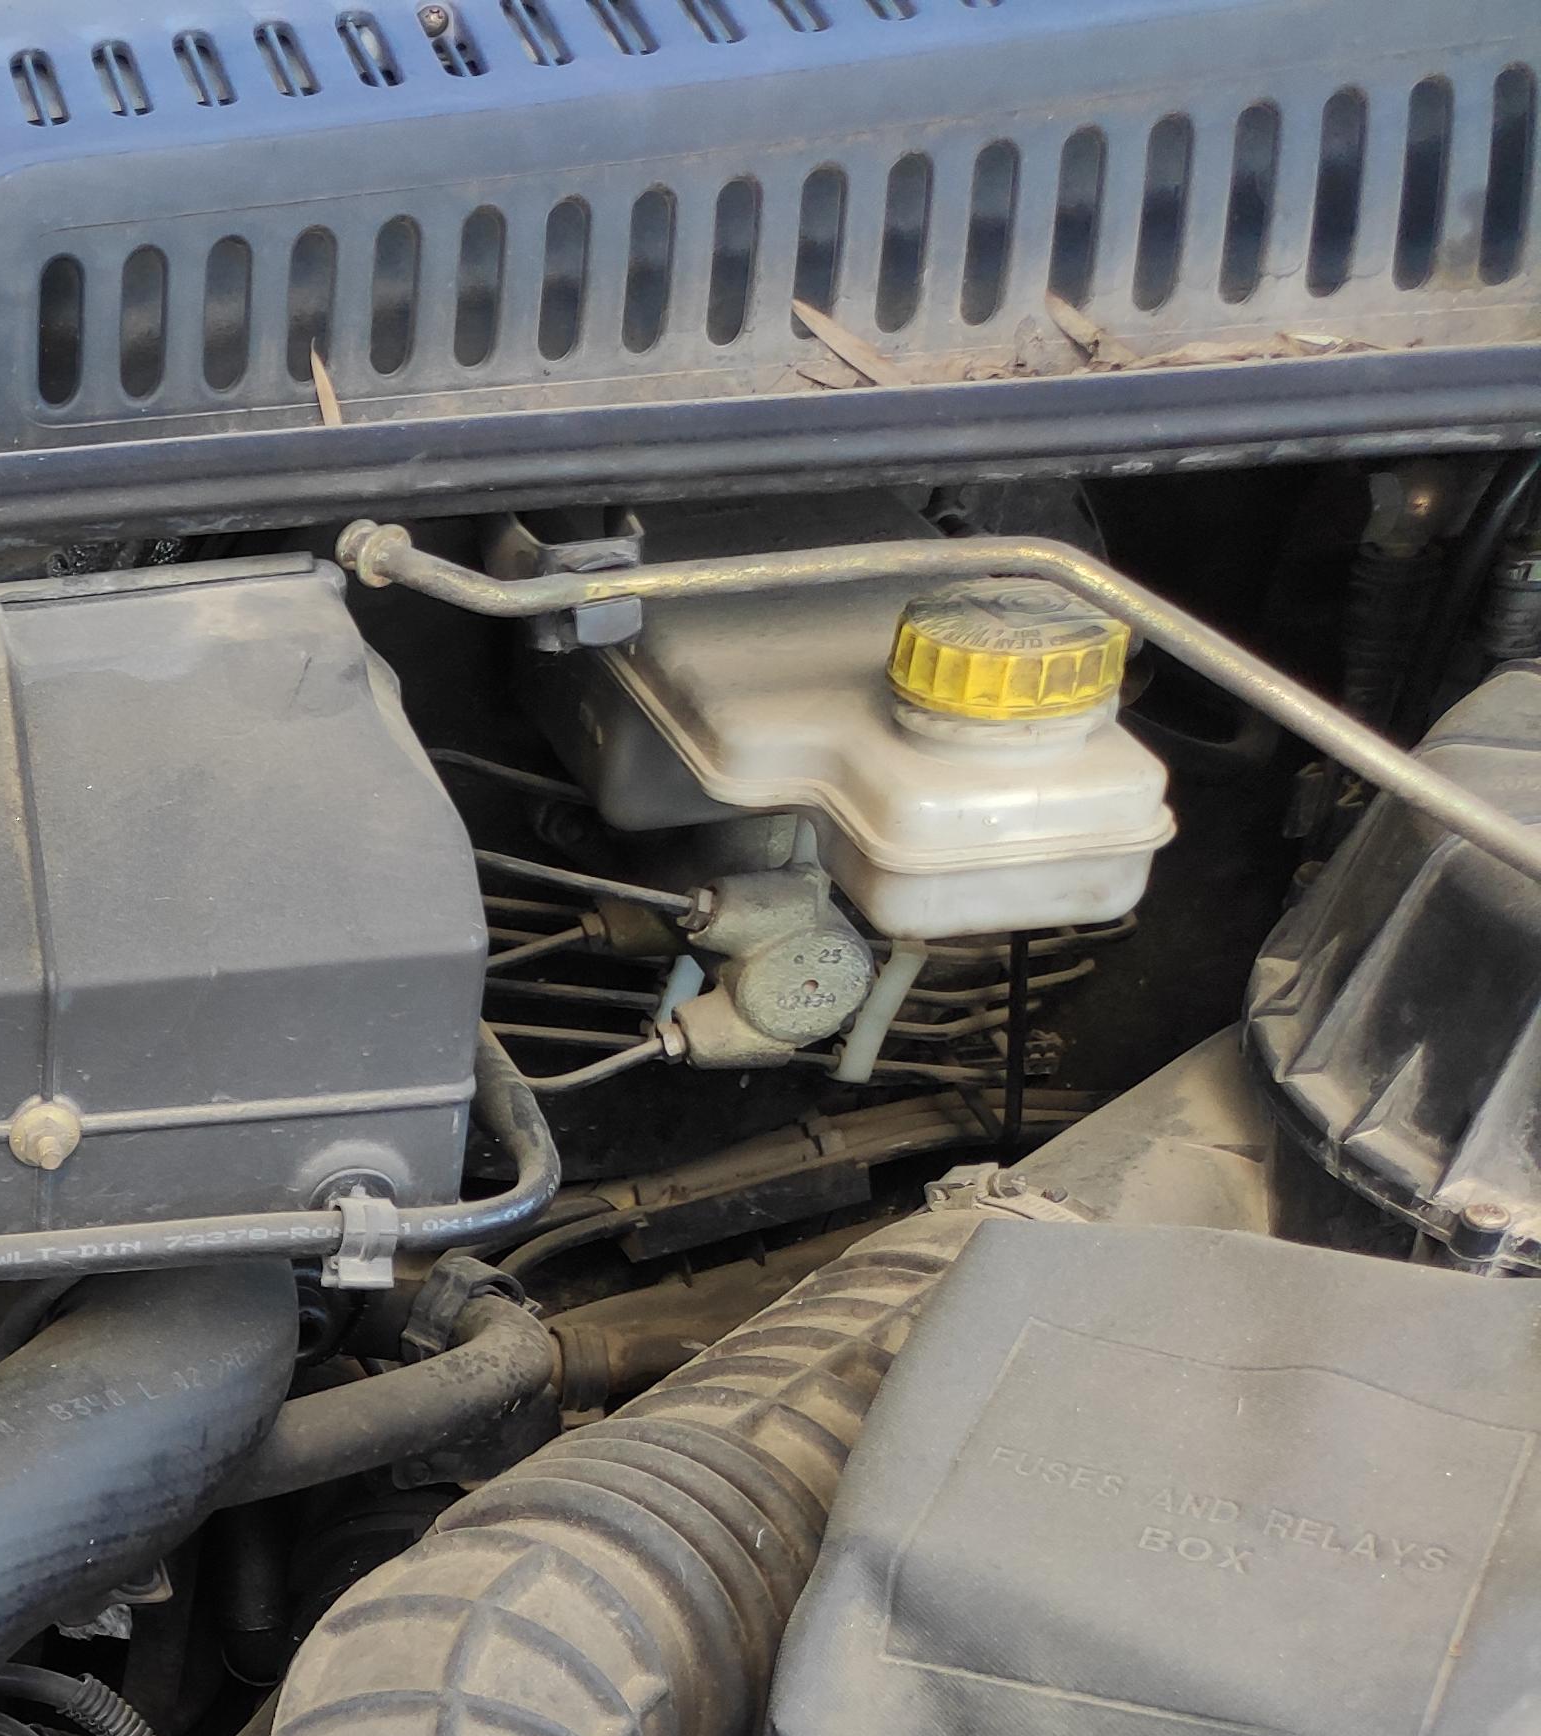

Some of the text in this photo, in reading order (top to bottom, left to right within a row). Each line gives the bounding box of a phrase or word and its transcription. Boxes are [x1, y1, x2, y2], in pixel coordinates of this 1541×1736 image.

[988, 1445, 1453, 1573] FUSES AND RELAYS
[1139, 1526, 1253, 1575] BOX
